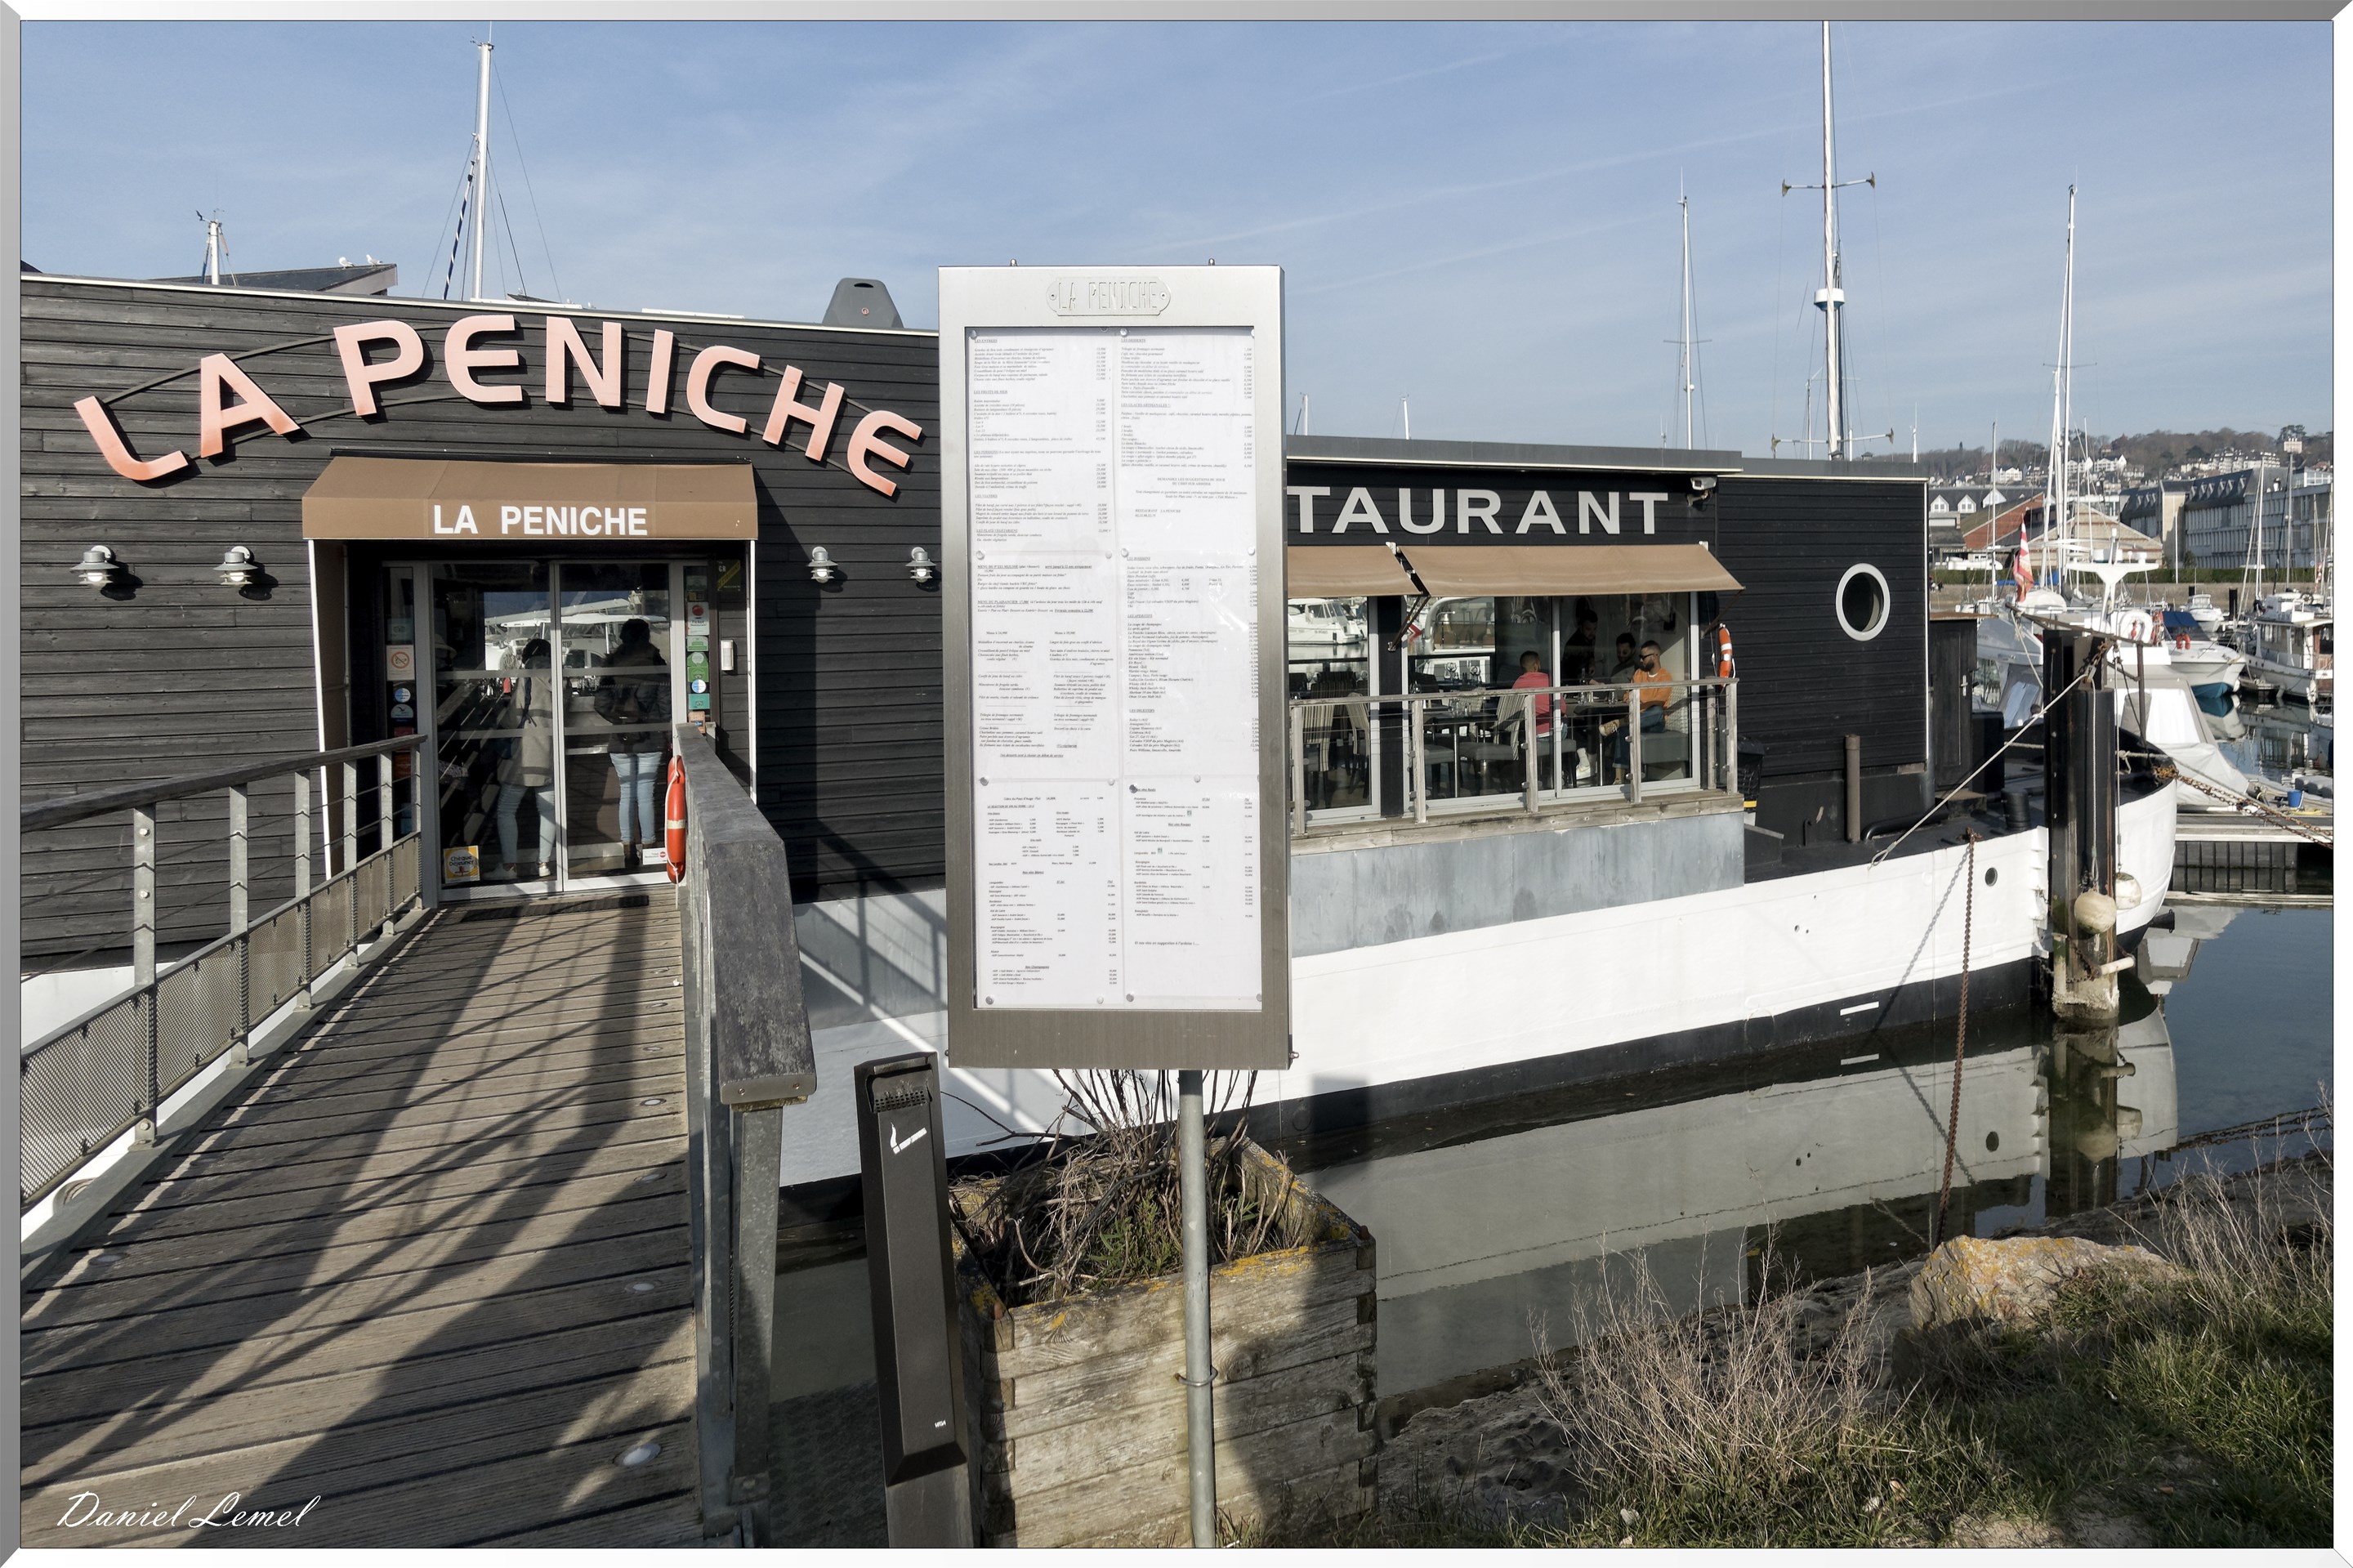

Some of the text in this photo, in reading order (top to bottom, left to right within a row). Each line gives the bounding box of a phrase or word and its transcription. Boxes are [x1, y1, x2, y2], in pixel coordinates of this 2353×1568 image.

[1058, 282, 1158, 310] LA PENICHE
[74, 315, 923, 497] LA PENICHE
[434, 505, 648, 536] LA PENICHE
